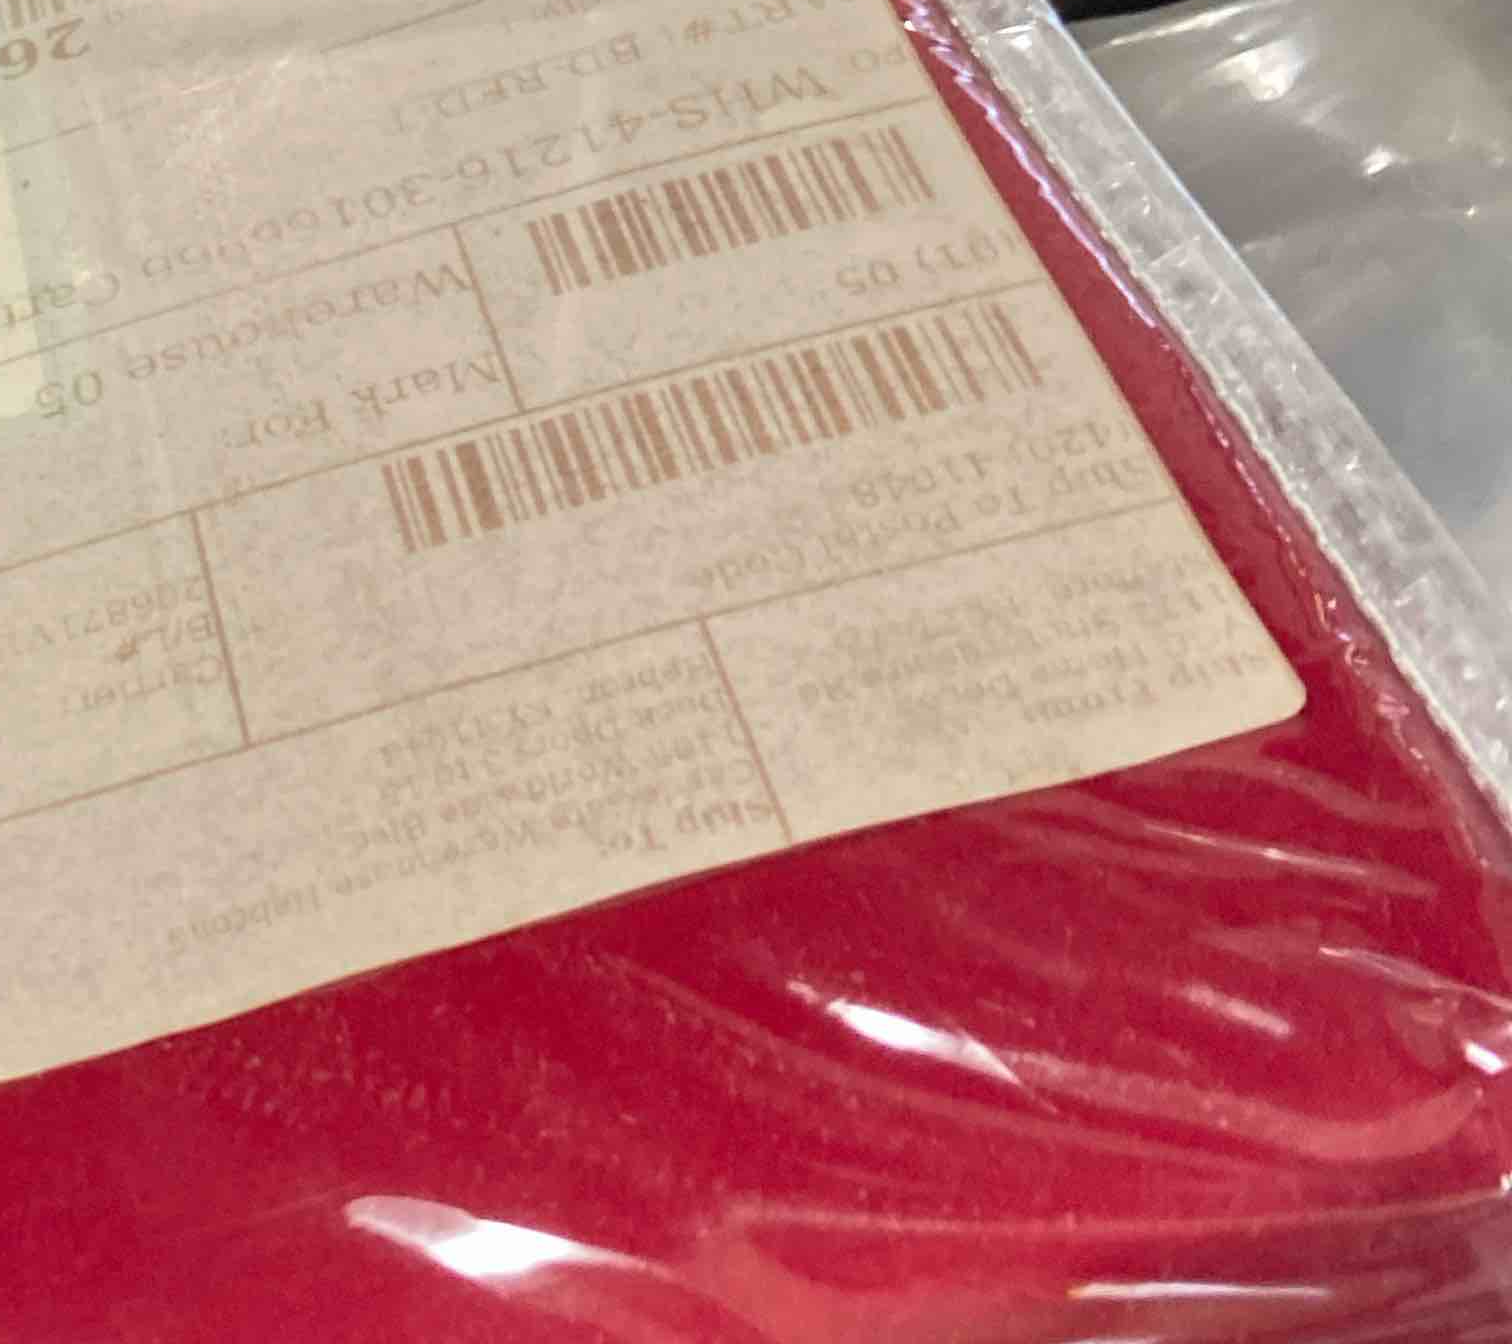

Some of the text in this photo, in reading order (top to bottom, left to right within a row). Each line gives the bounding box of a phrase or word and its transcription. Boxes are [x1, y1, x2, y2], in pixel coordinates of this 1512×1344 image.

[830, 254, 903, 300] 05
[31, 251, 473, 425] Warehouse 05
[217, 346, 503, 463] Mark For:
[845, 444, 997, 516] 41048
[969, 482, 1037, 525] To
[1038, 443, 1160, 512] Ship
[816, 497, 964, 568] Postal
[593, 788, 774, 866] Ship To:
